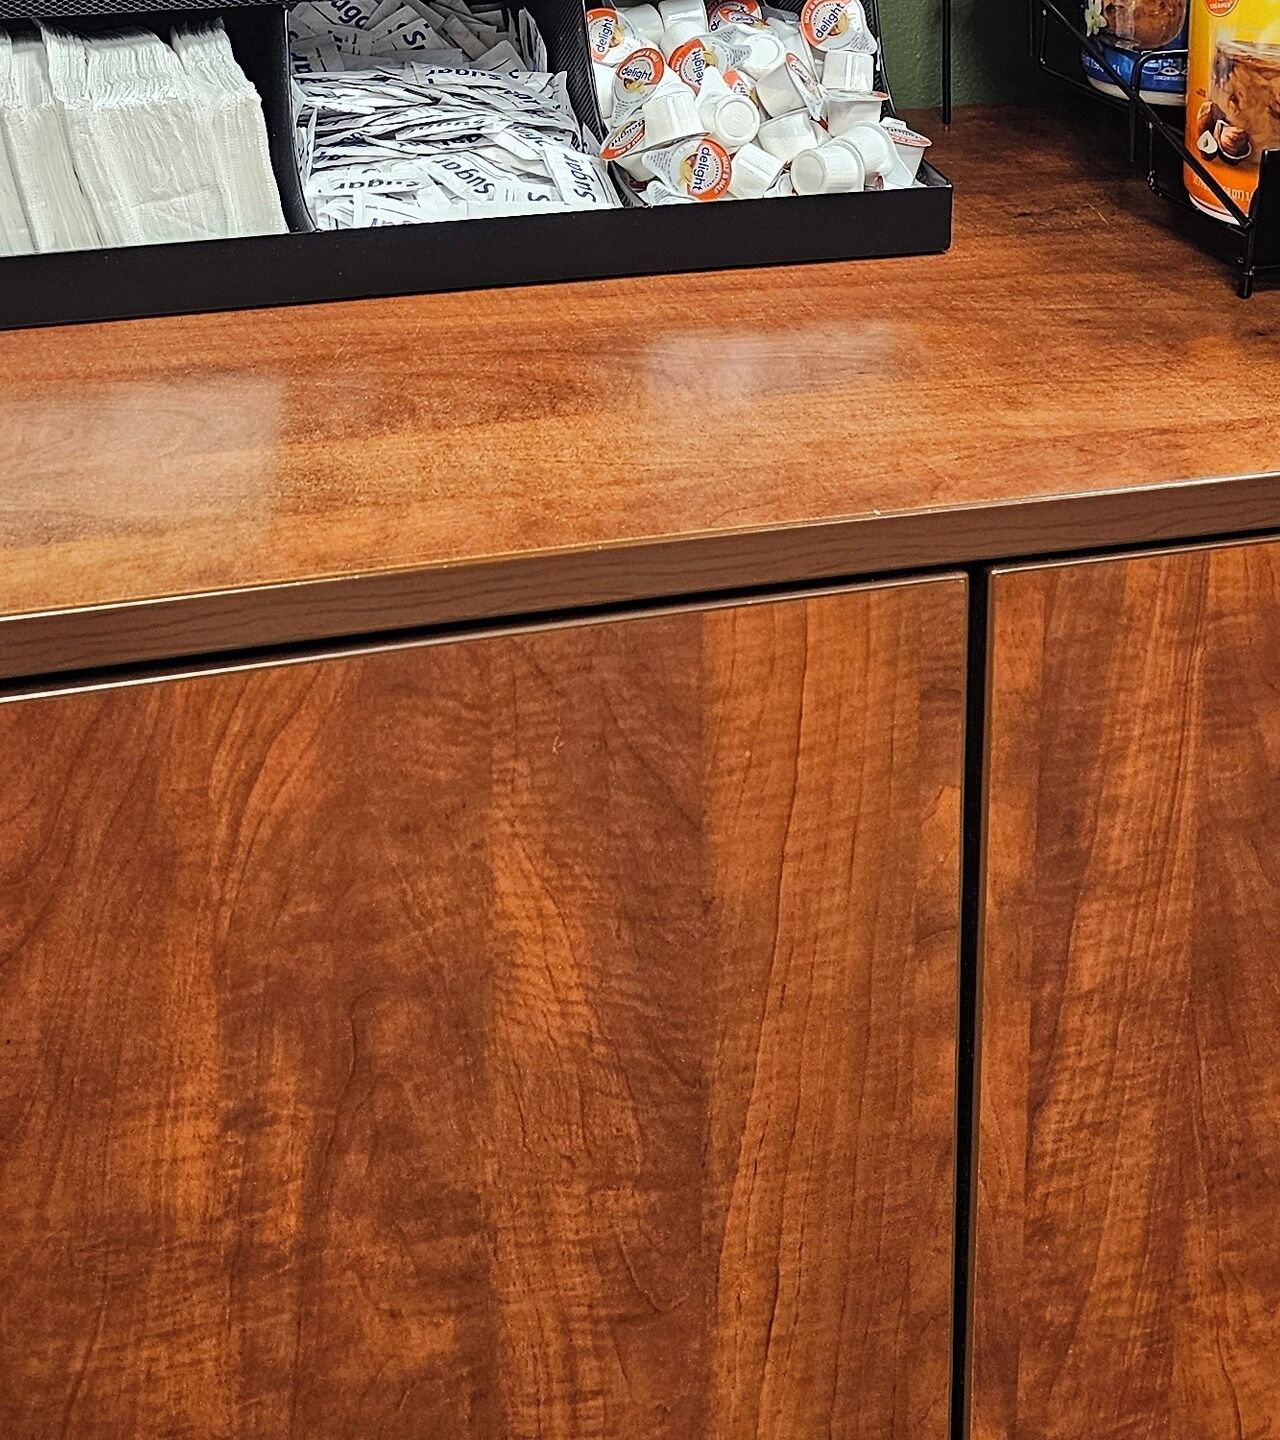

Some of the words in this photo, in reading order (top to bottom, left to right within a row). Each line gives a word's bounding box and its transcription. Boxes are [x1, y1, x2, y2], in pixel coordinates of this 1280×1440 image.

[596, 17, 613, 53] delight
[815, 2, 845, 38] delight
[621, 67, 653, 82] delight
[692, 147, 710, 191] delight
